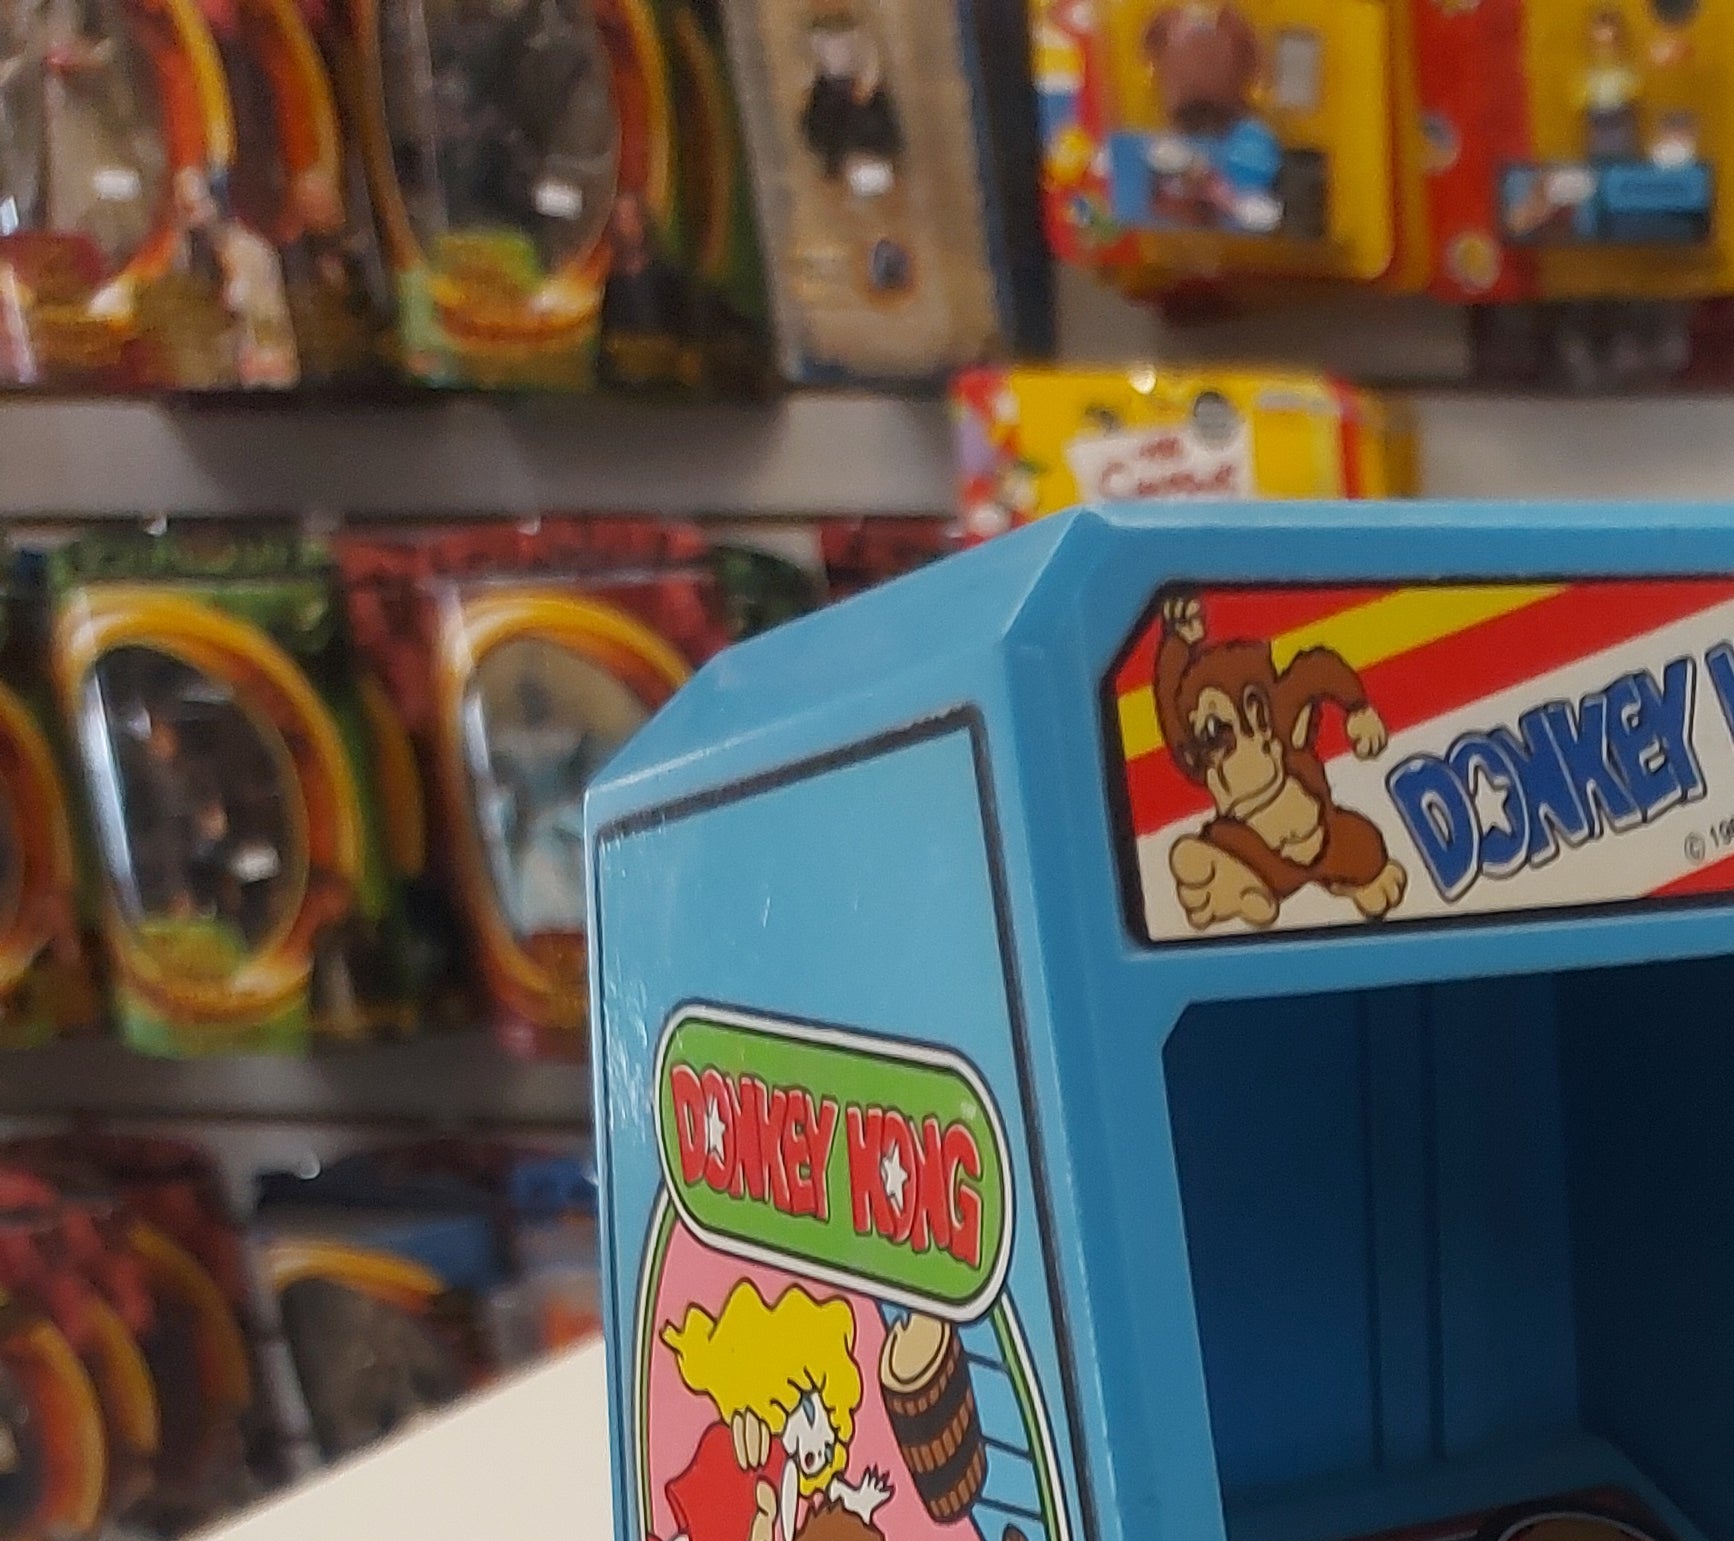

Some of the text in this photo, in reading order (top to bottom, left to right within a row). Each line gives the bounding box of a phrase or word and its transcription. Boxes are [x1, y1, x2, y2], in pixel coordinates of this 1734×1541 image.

[1386, 655, 1706, 901] DONKEY
[670, 1064, 982, 1269] DONKEY KONG
